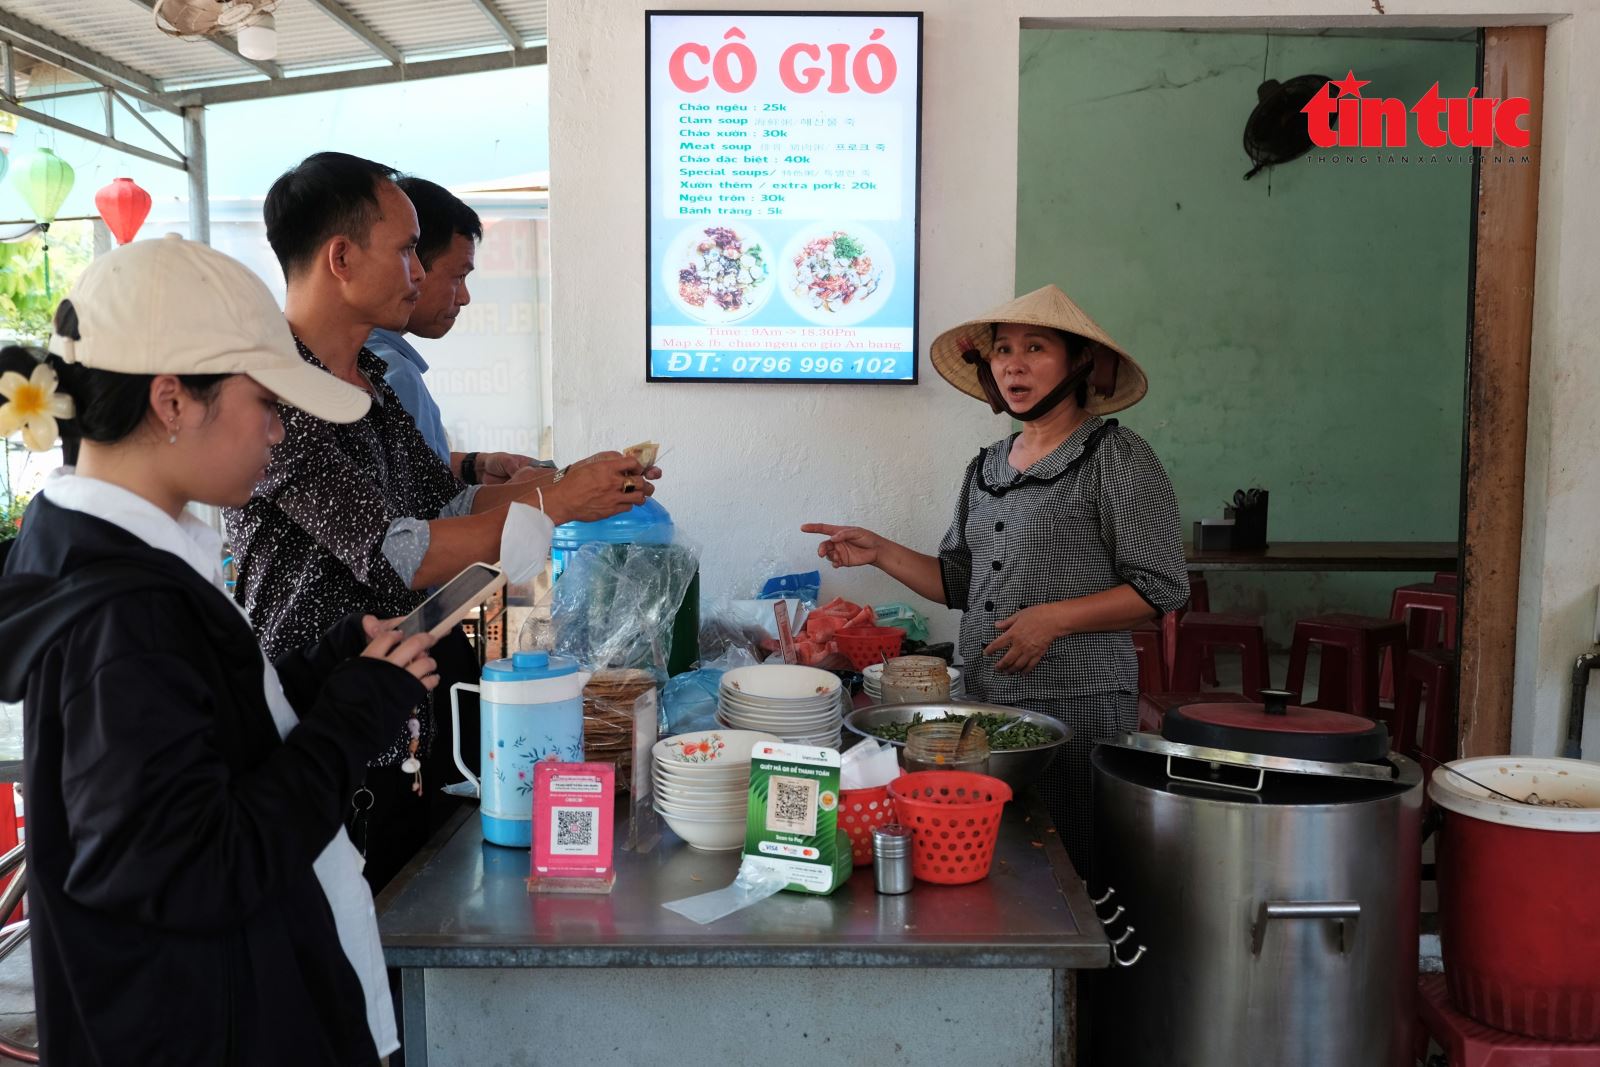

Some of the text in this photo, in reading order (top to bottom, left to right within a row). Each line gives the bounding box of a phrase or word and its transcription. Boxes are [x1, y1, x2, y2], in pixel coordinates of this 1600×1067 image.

[668, 26, 898, 94] CÔ GIÓ
[679, 102, 710, 112] Cháo
[762, 103, 787, 112] 25k
[679, 116, 712, 124] Clam
[718, 118, 748, 126] soup
[679, 128, 710, 138] Cháo
[762, 129, 788, 138] 30k
[679, 142, 716, 150] Meat
[722, 144, 752, 152] soup
[679, 154, 710, 164] Cháo
[784, 155, 810, 164] 40k
[679, 168, 726, 178] Special
[772, 182, 808, 190] extra
[852, 182, 877, 190] 20k
[761, 194, 785, 202] 30k
[768, 207, 782, 216] 5k
[707, 328, 740, 336] Time
[752, 328, 782, 336] 9Am
[663, 338, 691, 348] Map
[667, 352, 896, 374] ĐT: 0796 996 102
